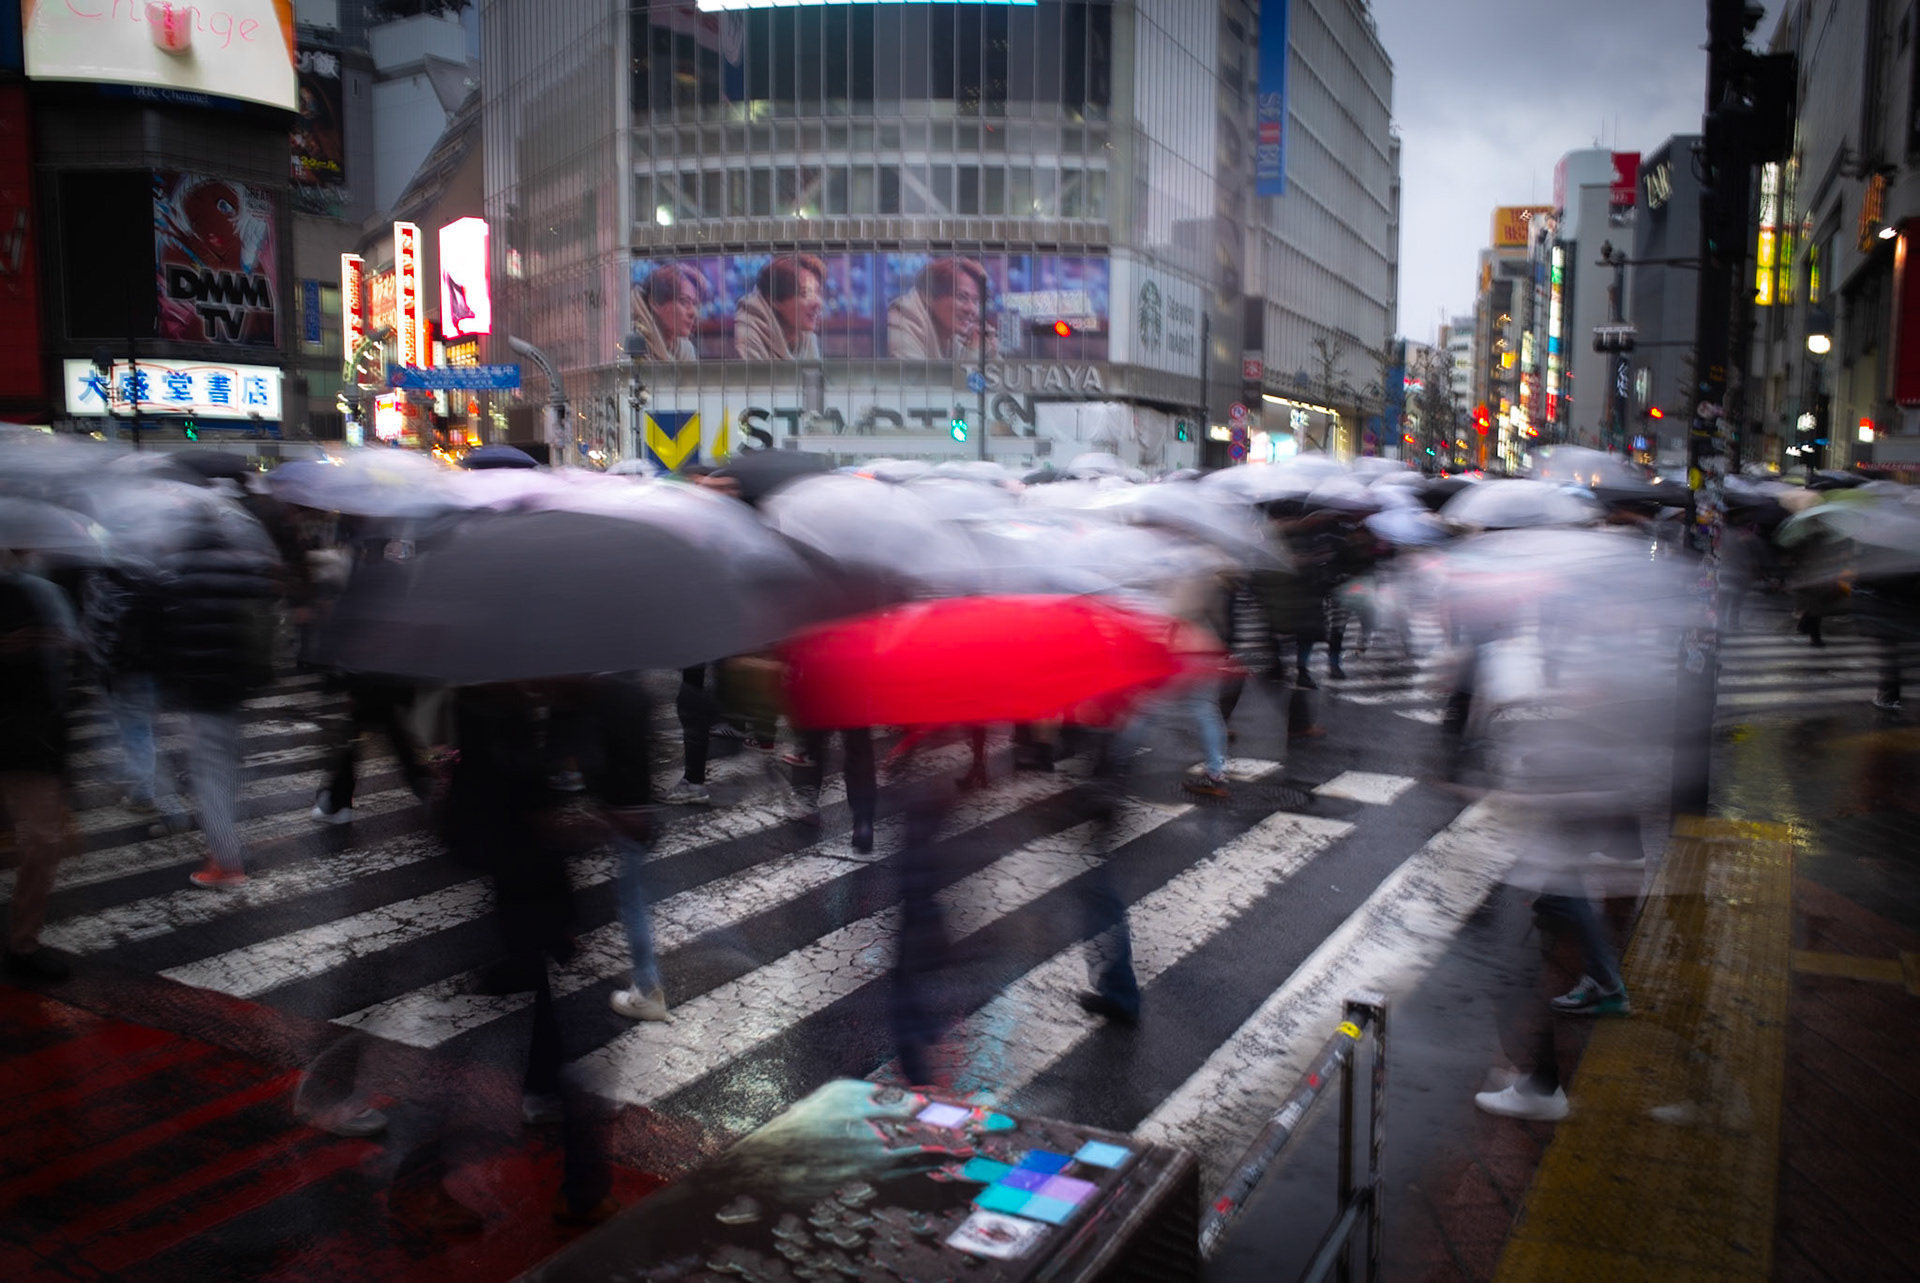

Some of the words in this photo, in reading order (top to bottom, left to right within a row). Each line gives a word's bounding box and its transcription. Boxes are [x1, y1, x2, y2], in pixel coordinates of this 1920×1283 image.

[166, 264, 271, 309] DMM
[196, 302, 245, 340] TV
[78, 369, 268, 405] 大盛堂書店
[960, 362, 1104, 392] TSUTAYA
